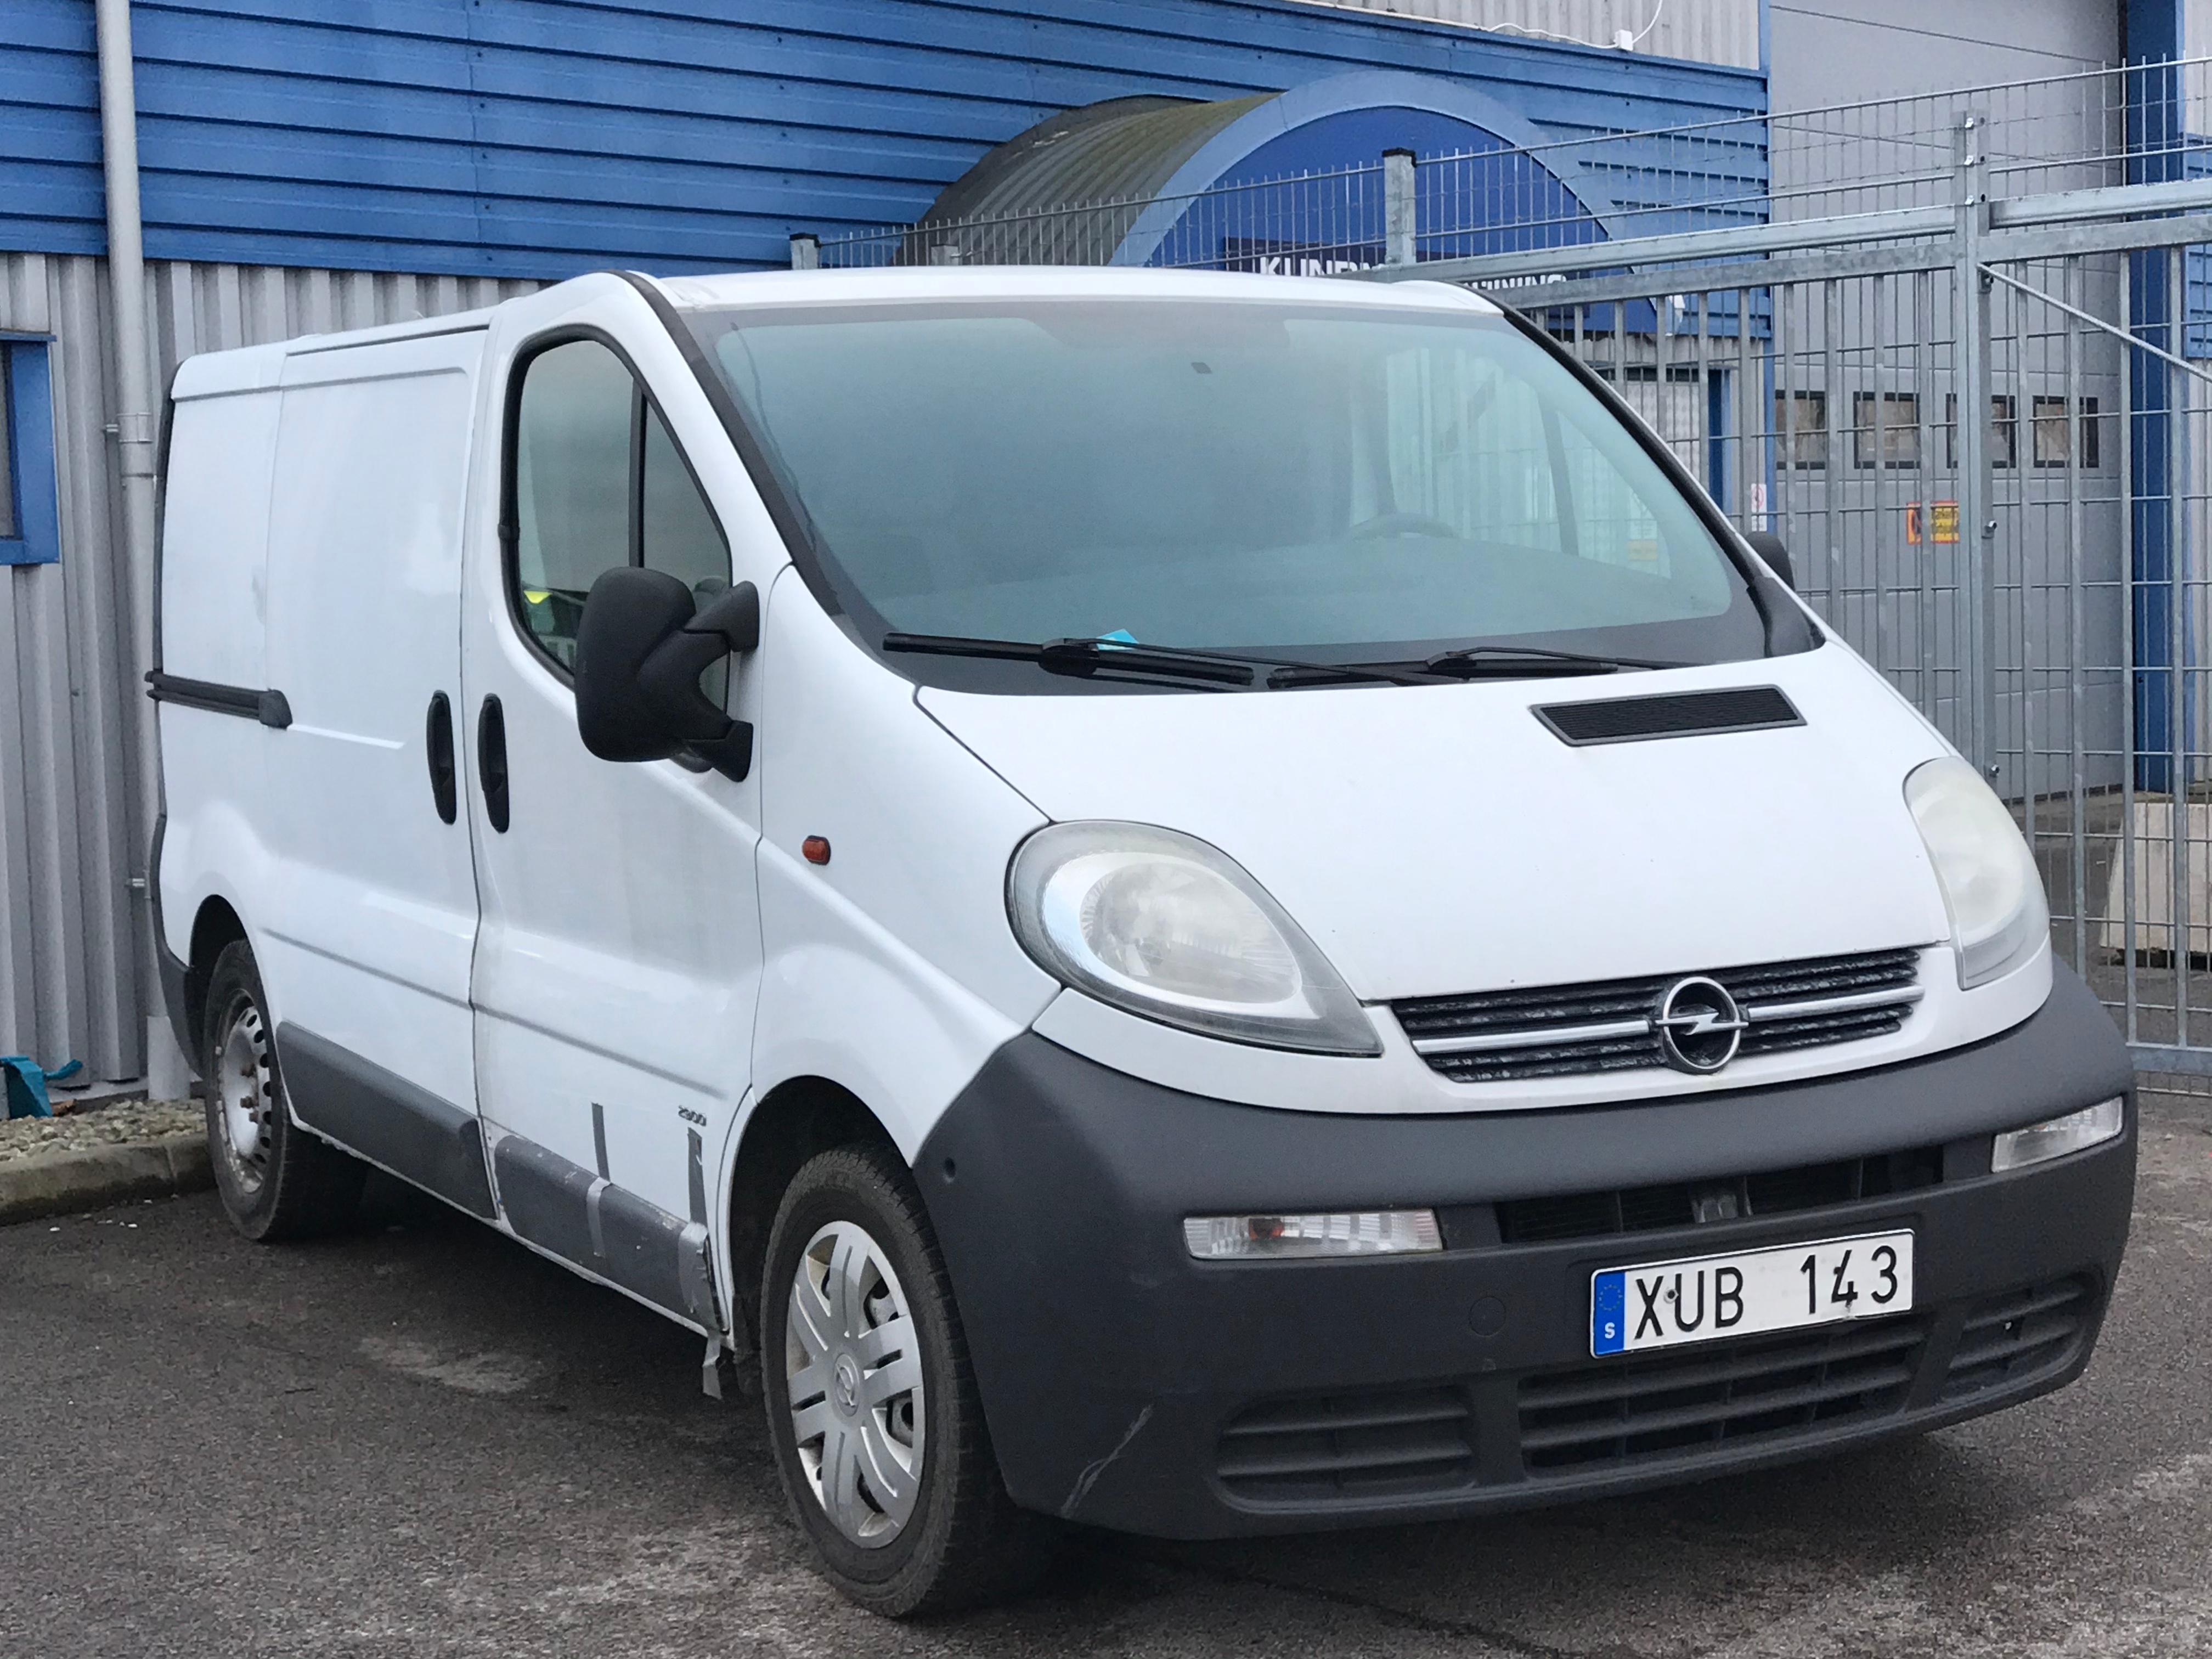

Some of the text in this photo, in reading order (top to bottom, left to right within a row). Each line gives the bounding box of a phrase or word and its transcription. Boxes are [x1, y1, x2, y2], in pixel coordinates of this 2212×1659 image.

[1634, 1245, 1898, 1340] XUB 143
[1604, 1322, 1616, 1339] S
